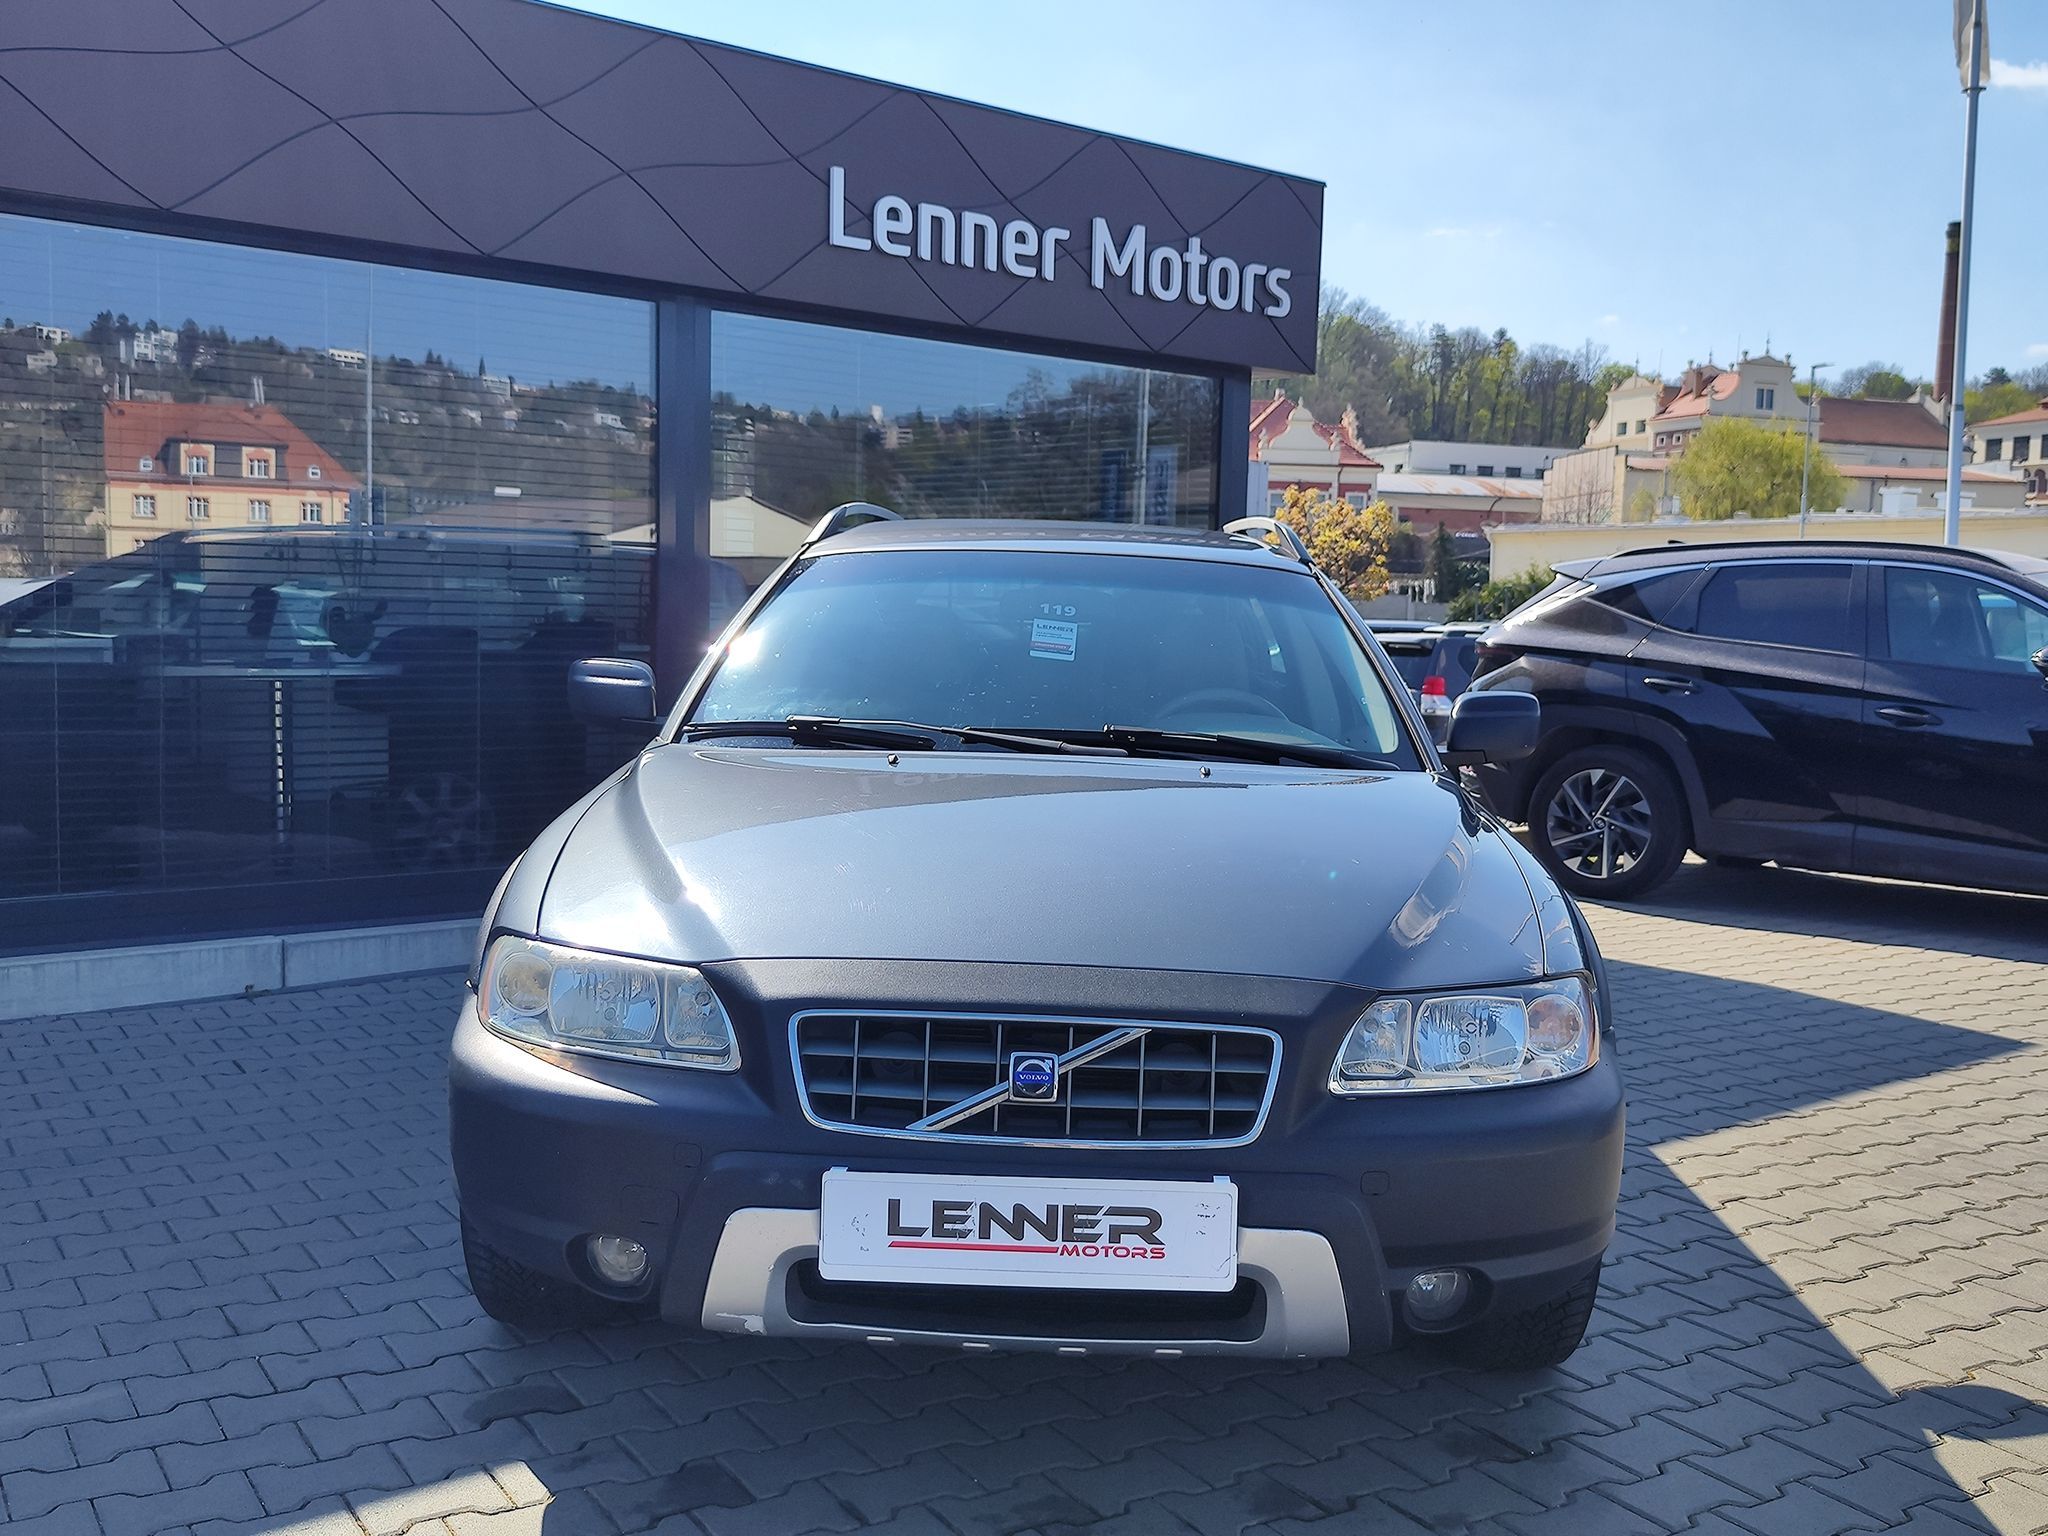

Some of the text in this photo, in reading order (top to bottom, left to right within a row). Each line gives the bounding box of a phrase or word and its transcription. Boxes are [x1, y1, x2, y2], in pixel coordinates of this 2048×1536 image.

[829, 166, 1291, 318] Lenner Motors
[1040, 603, 1076, 616] 119
[887, 1198, 1164, 1244] LENNER
[1059, 1244, 1166, 1259] MOTORS
